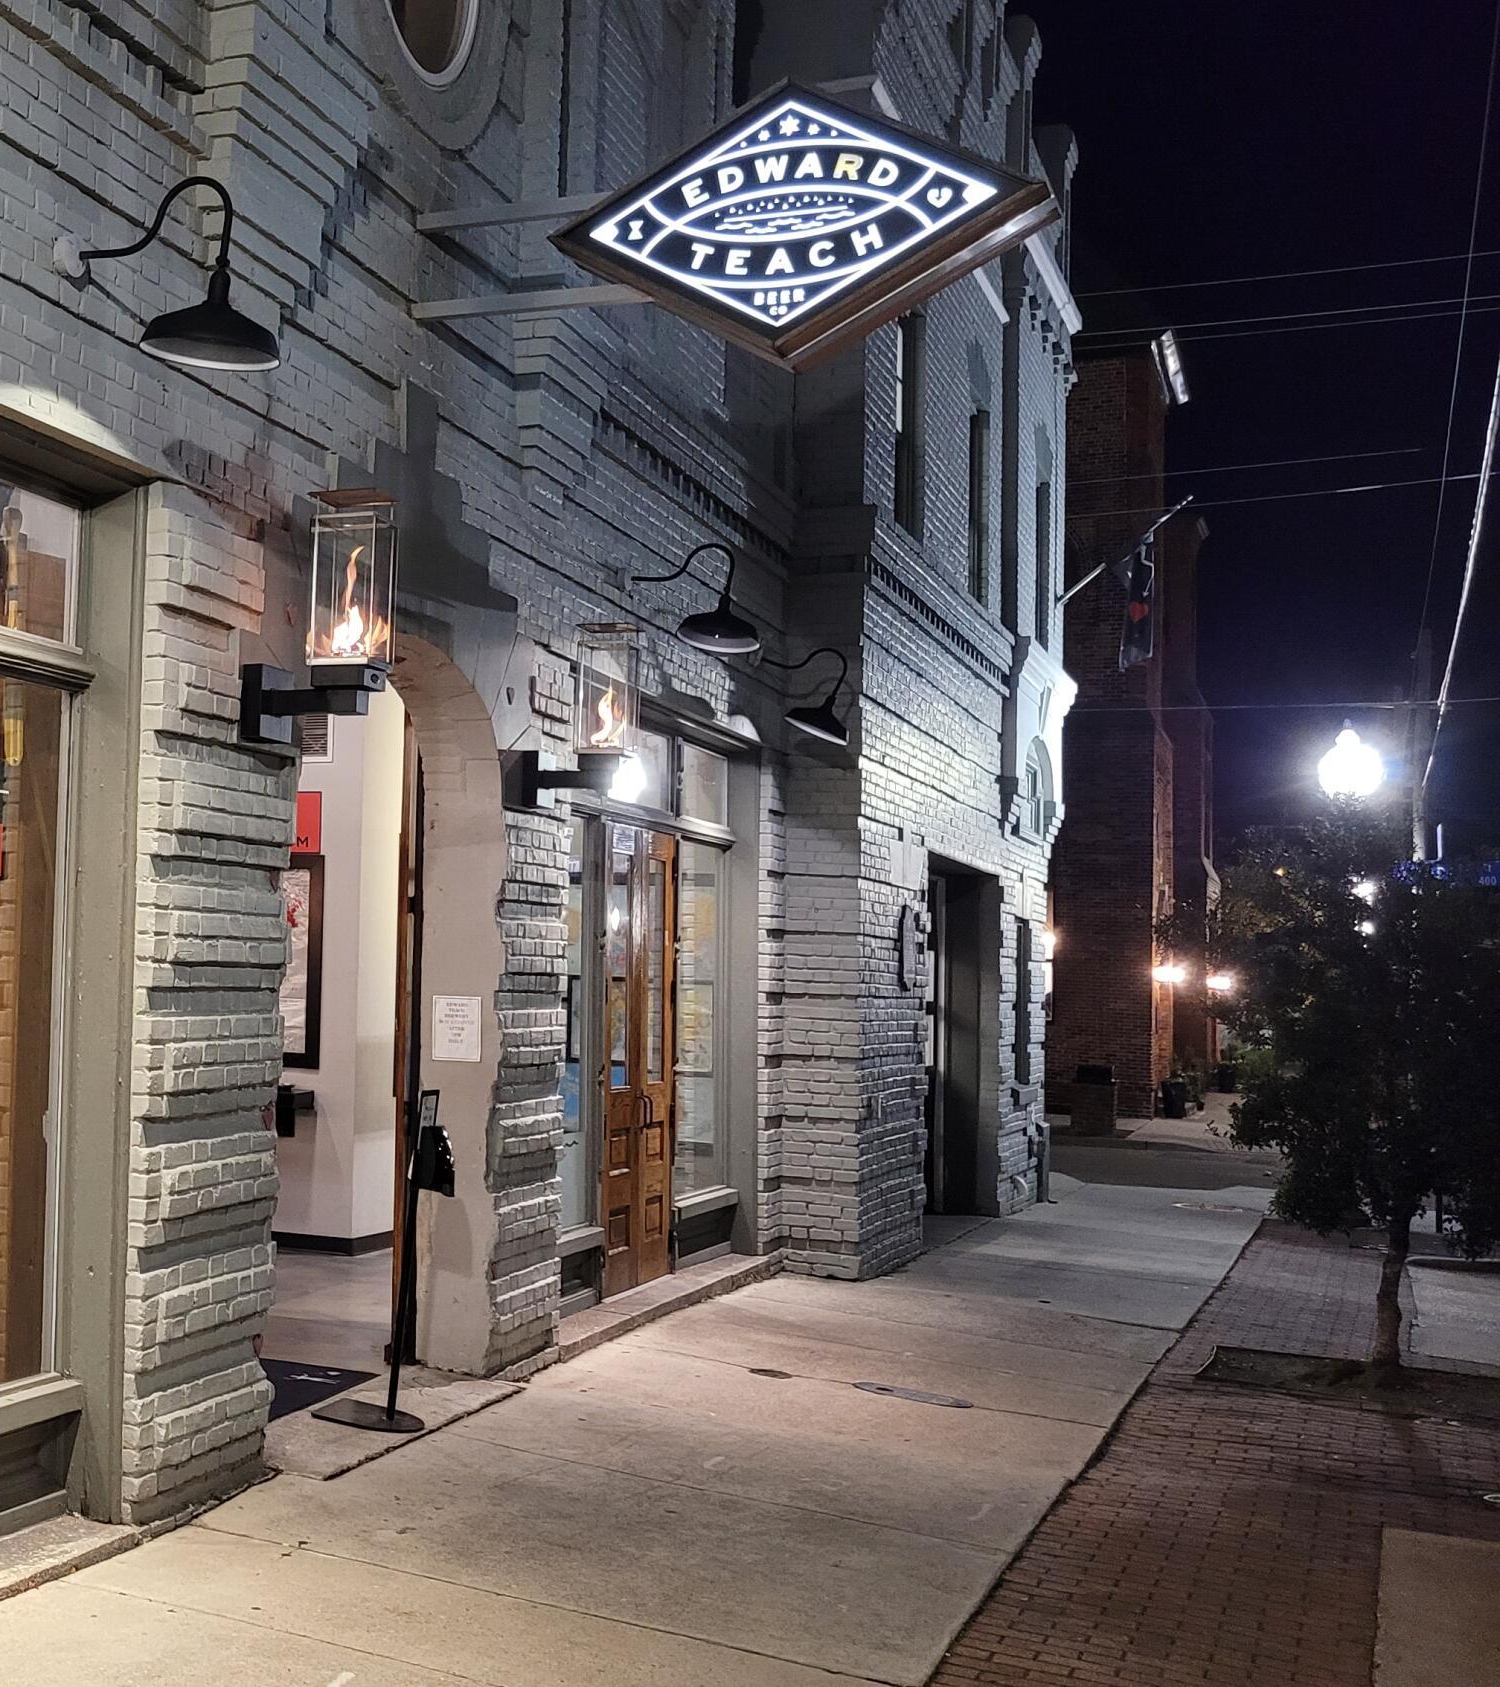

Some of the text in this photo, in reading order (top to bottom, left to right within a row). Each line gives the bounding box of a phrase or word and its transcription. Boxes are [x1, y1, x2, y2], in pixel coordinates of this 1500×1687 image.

[681, 152, 899, 209] EDWARD
[690, 223, 885, 275] TEACH
[753, 288, 805, 306] BEER
